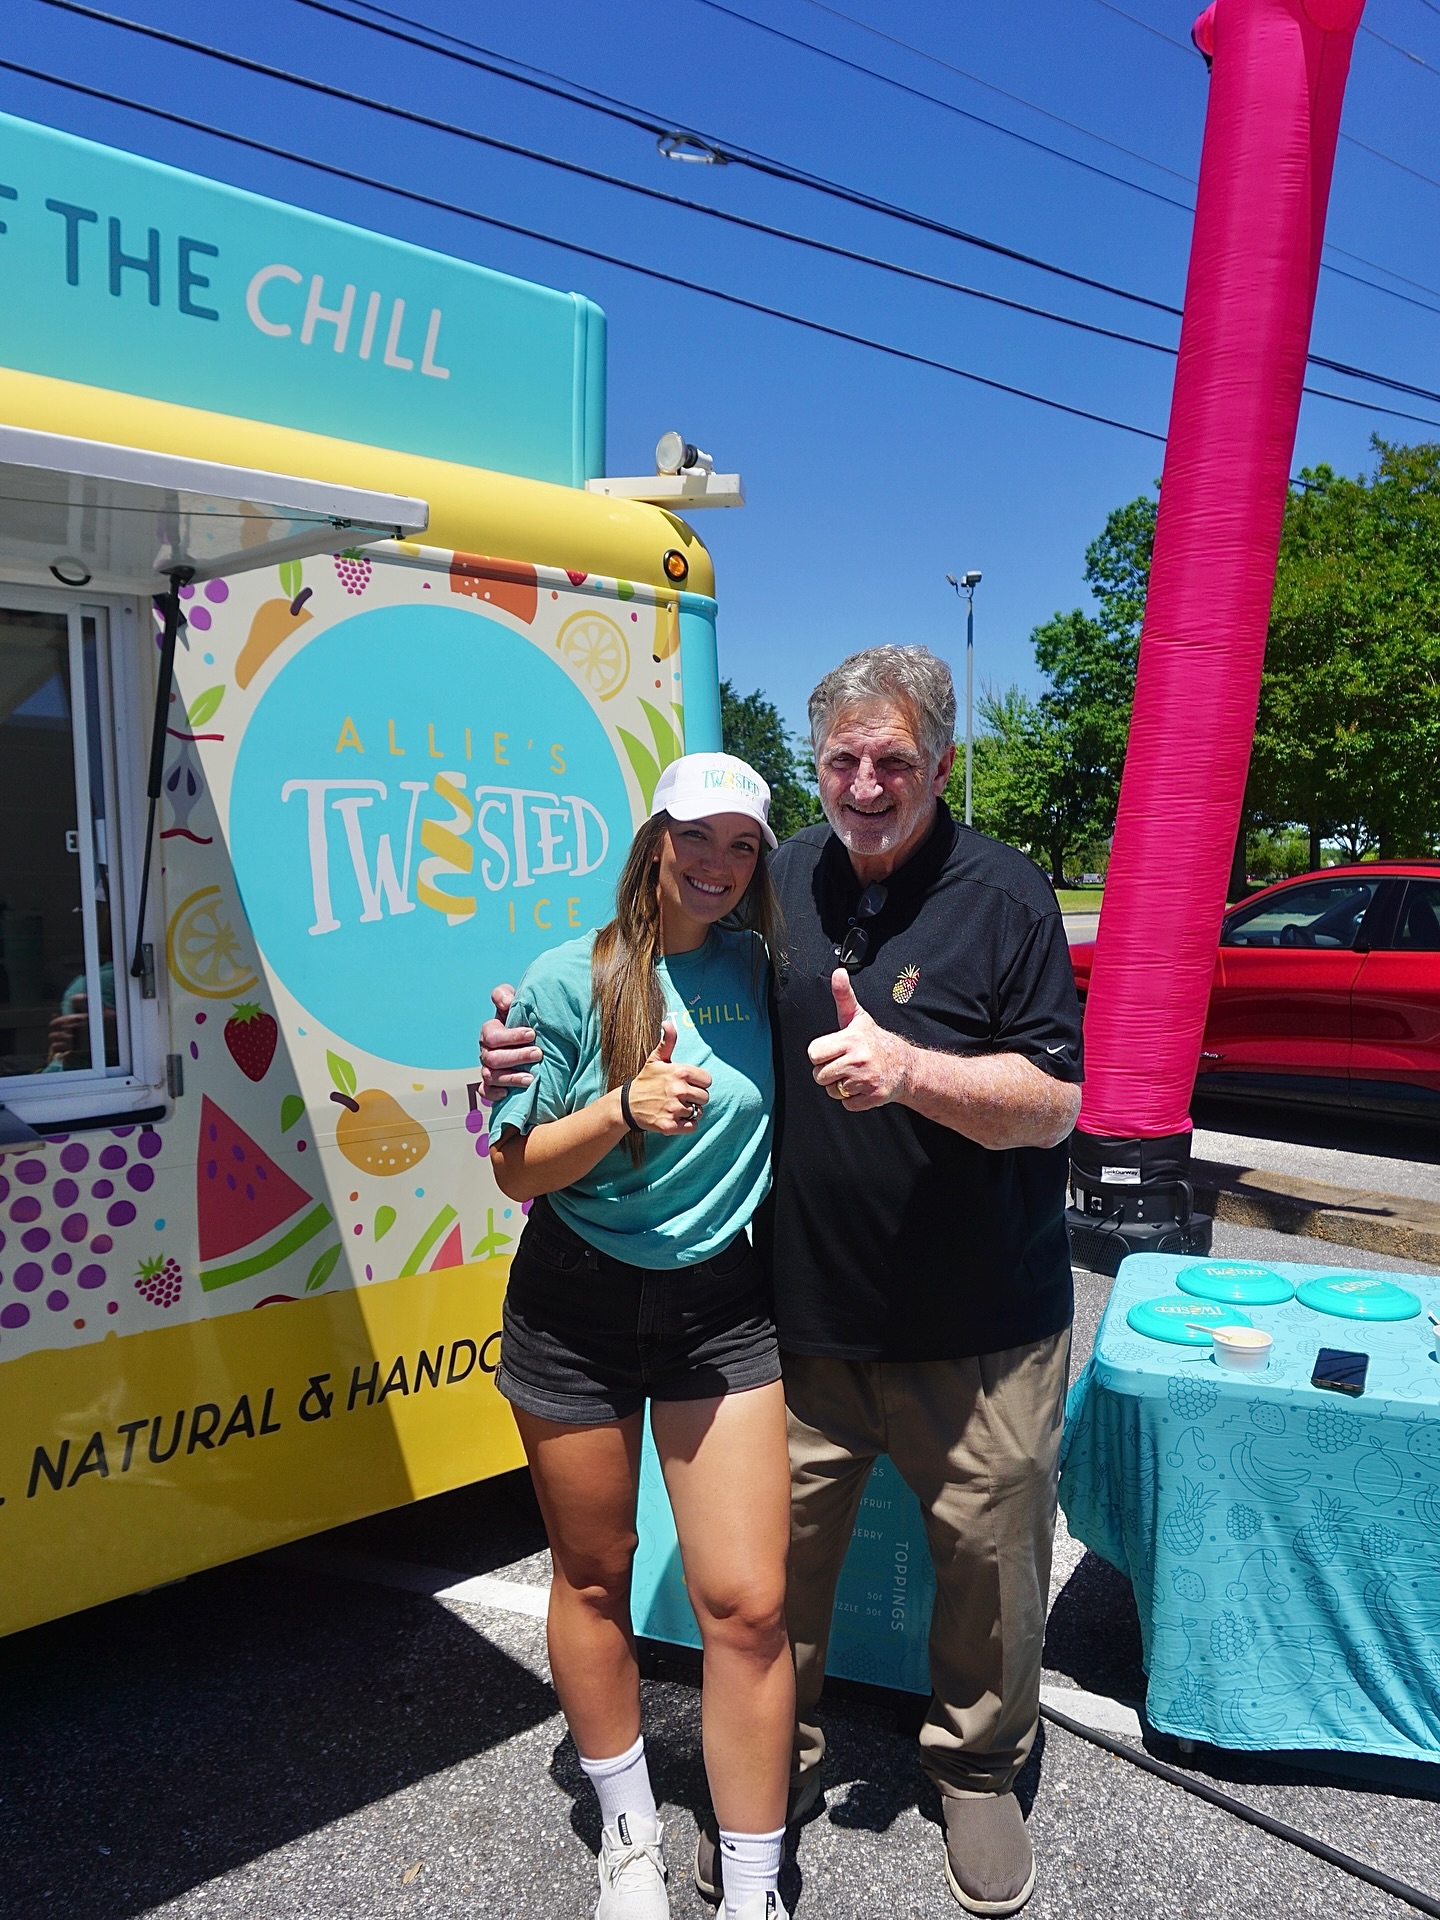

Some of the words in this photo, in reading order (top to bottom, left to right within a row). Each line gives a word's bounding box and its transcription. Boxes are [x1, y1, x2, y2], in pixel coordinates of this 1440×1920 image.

[45, 198, 219, 321] THE
[246, 264, 450, 379] CHILL
[335, 716, 566, 775] ALLIE'S
[509, 897, 581, 933] ICE
[27, 1388, 281, 1498] NATURAL
[299, 1373, 334, 1421] &
[891, 1541, 909, 1632] TOPPINGS
